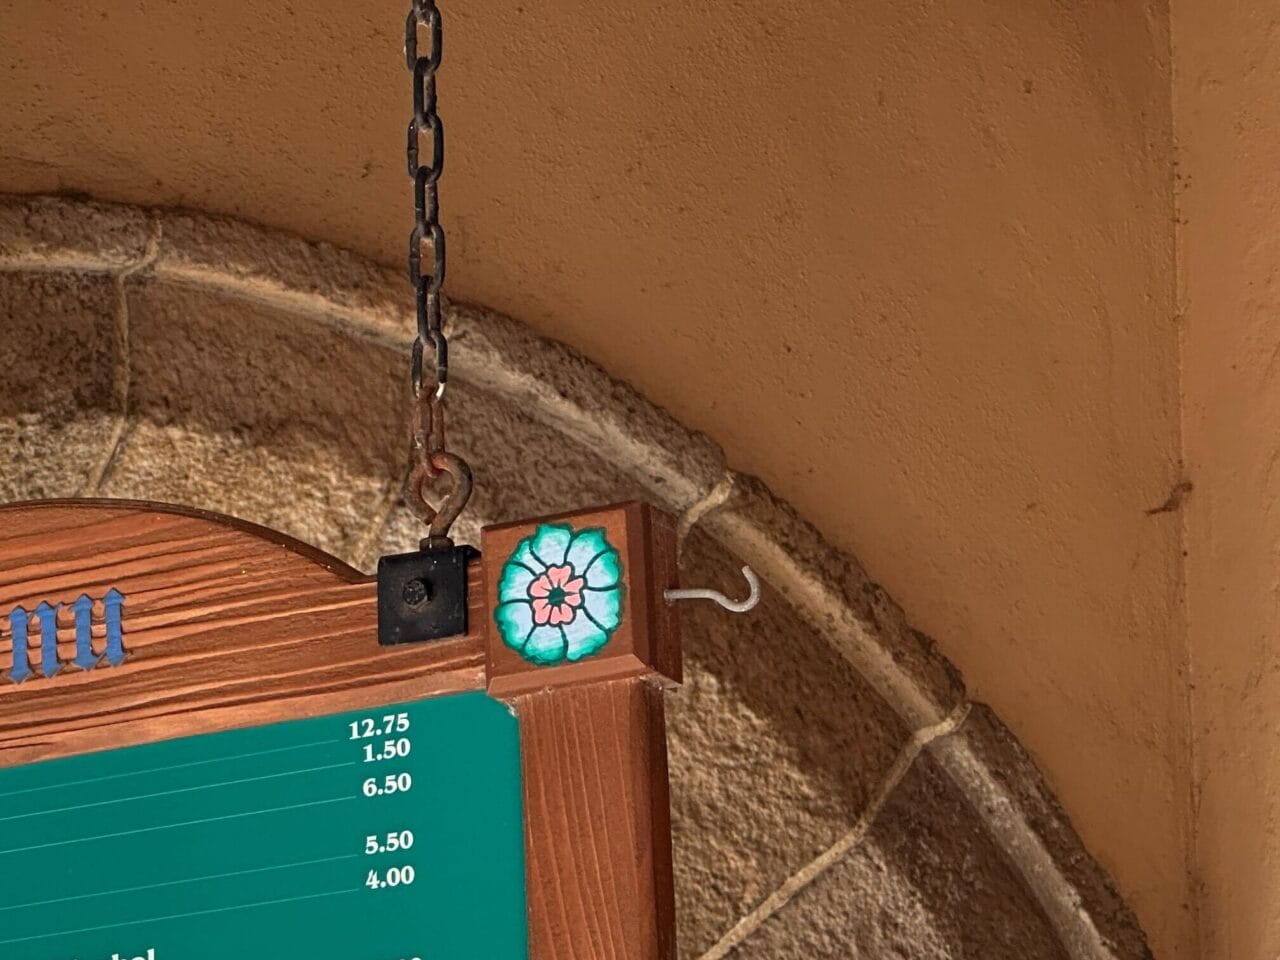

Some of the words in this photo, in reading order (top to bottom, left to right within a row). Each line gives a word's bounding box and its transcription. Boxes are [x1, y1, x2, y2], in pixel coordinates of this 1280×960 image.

[349, 712, 410, 740] 12.75
[363, 737, 411, 763] 1.50
[362, 772, 412, 797] 6.50
[365, 830, 414, 855] 5.50
[365, 865, 415, 890] 4.00
